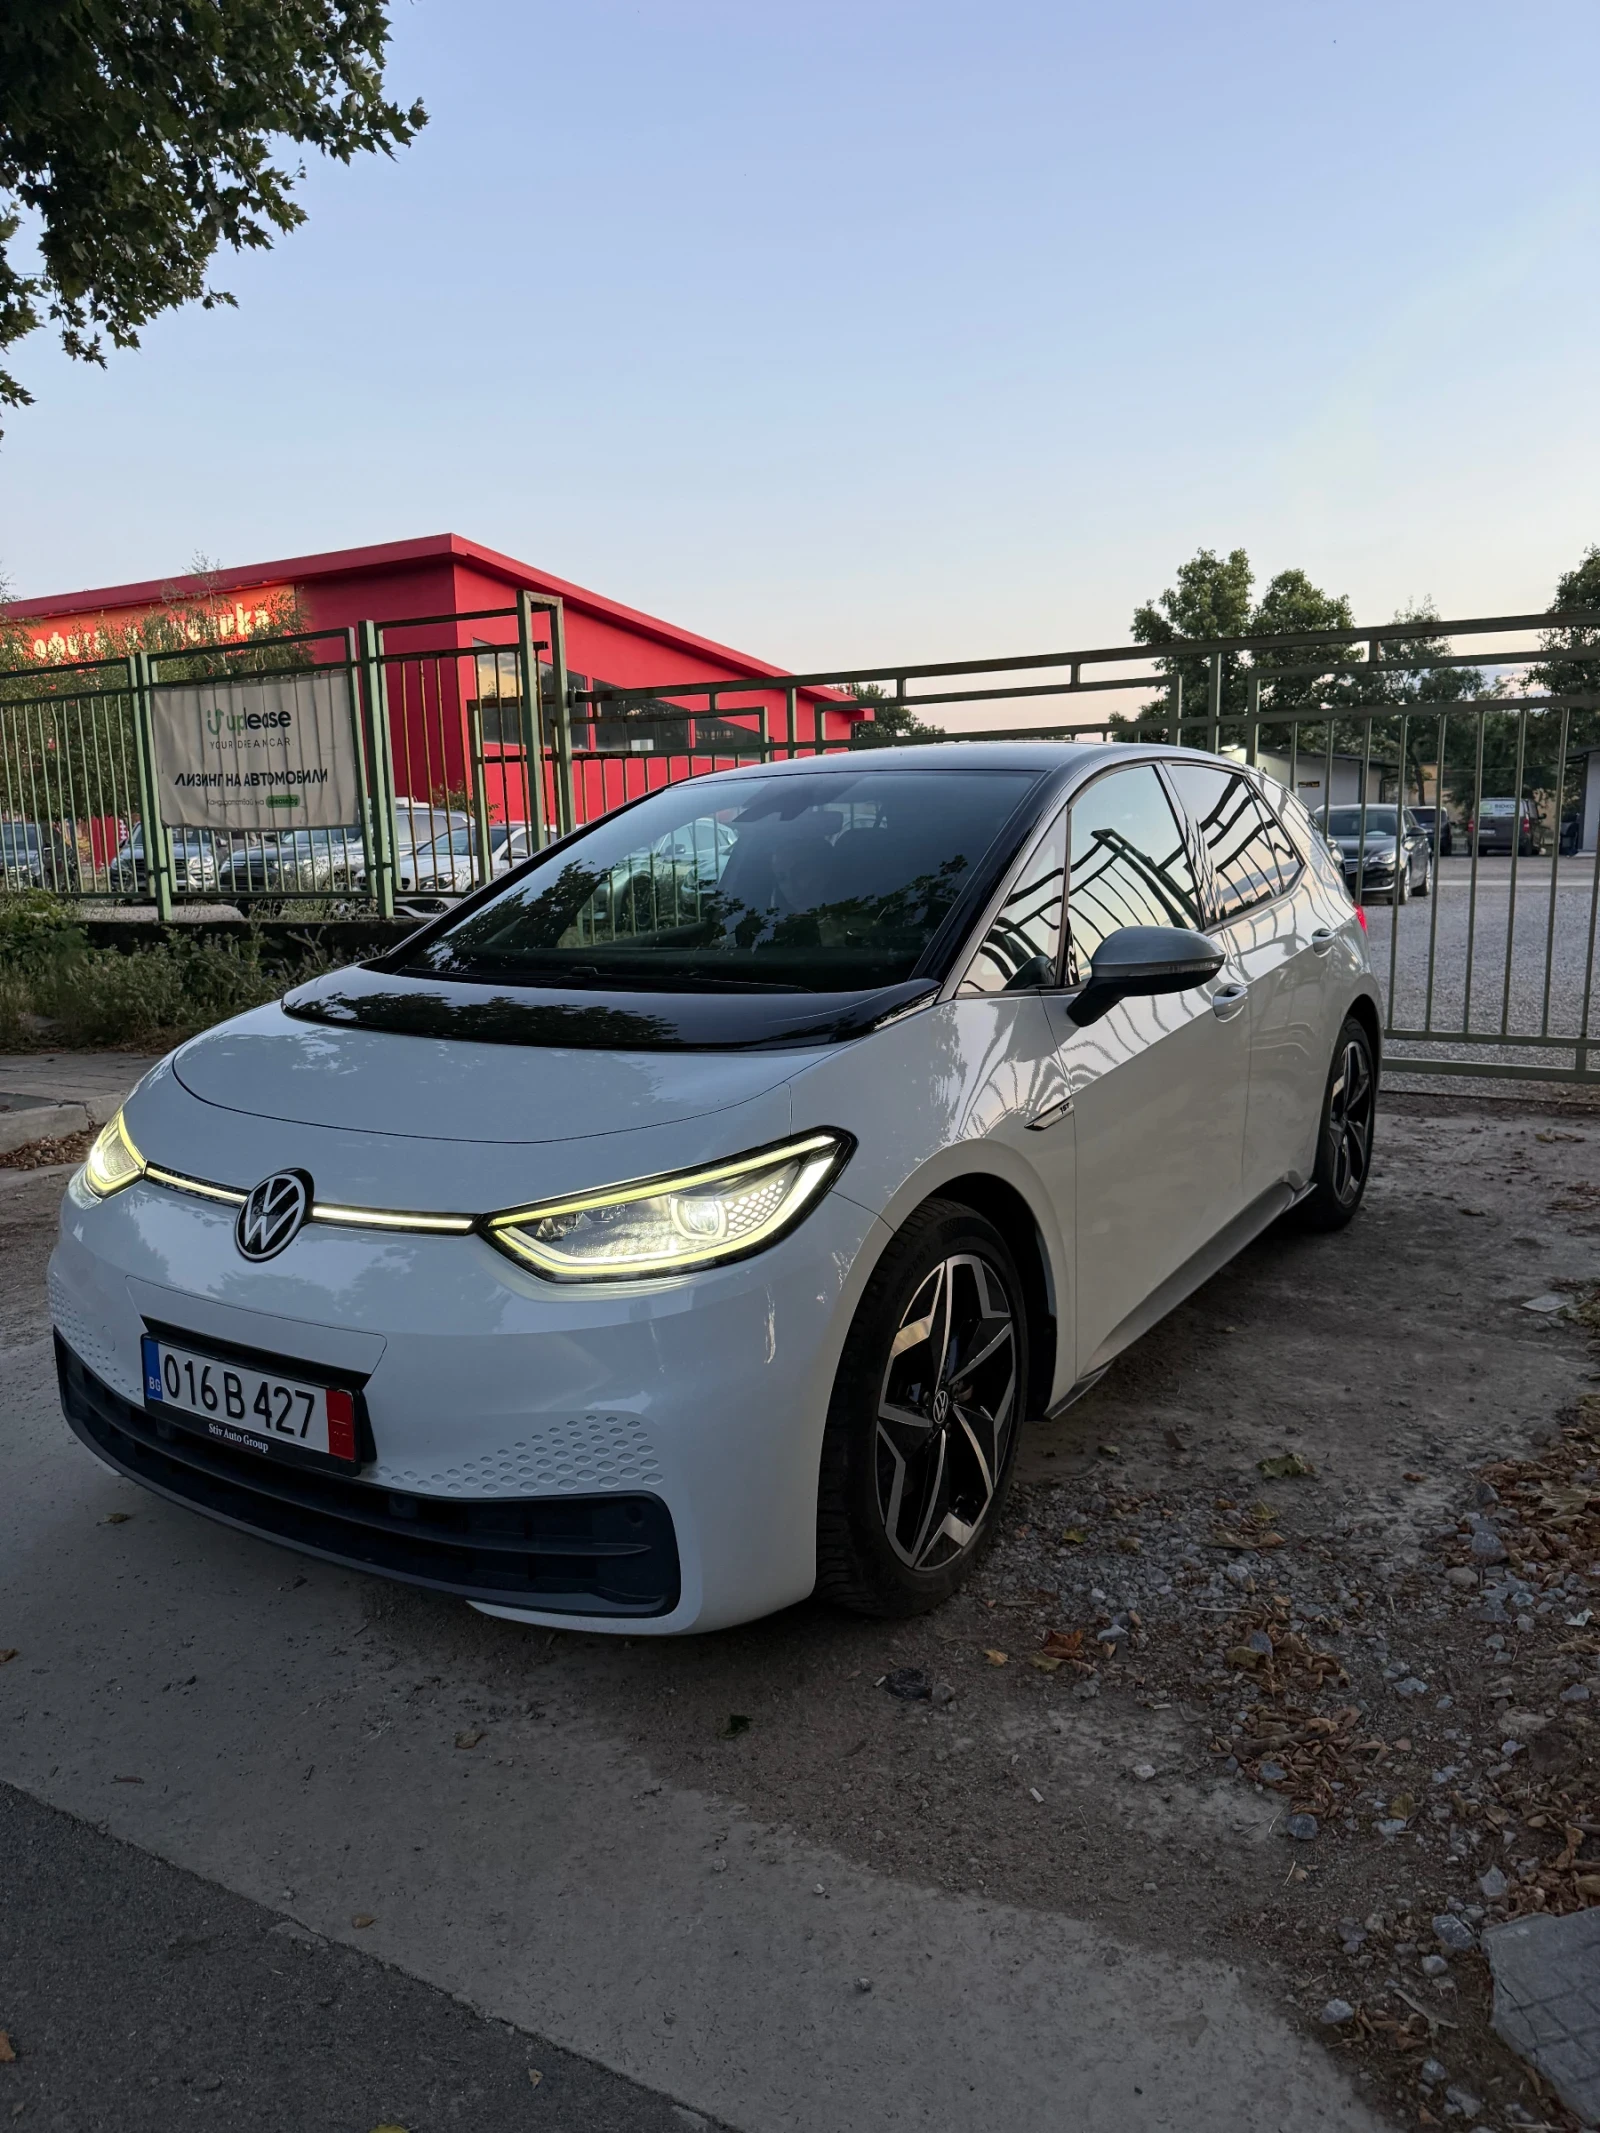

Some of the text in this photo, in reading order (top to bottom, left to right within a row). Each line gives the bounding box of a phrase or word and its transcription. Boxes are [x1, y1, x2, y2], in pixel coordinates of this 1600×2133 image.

[226, 707, 292, 736] uplease
[209, 741, 233, 750] YOUR
[174, 769, 328, 787] ЛИЗИНГ НА АВТОМОБИЛИ
[149, 1376, 161, 1392] BG
[208, 1423, 269, 1453] Stiv Auto Group
